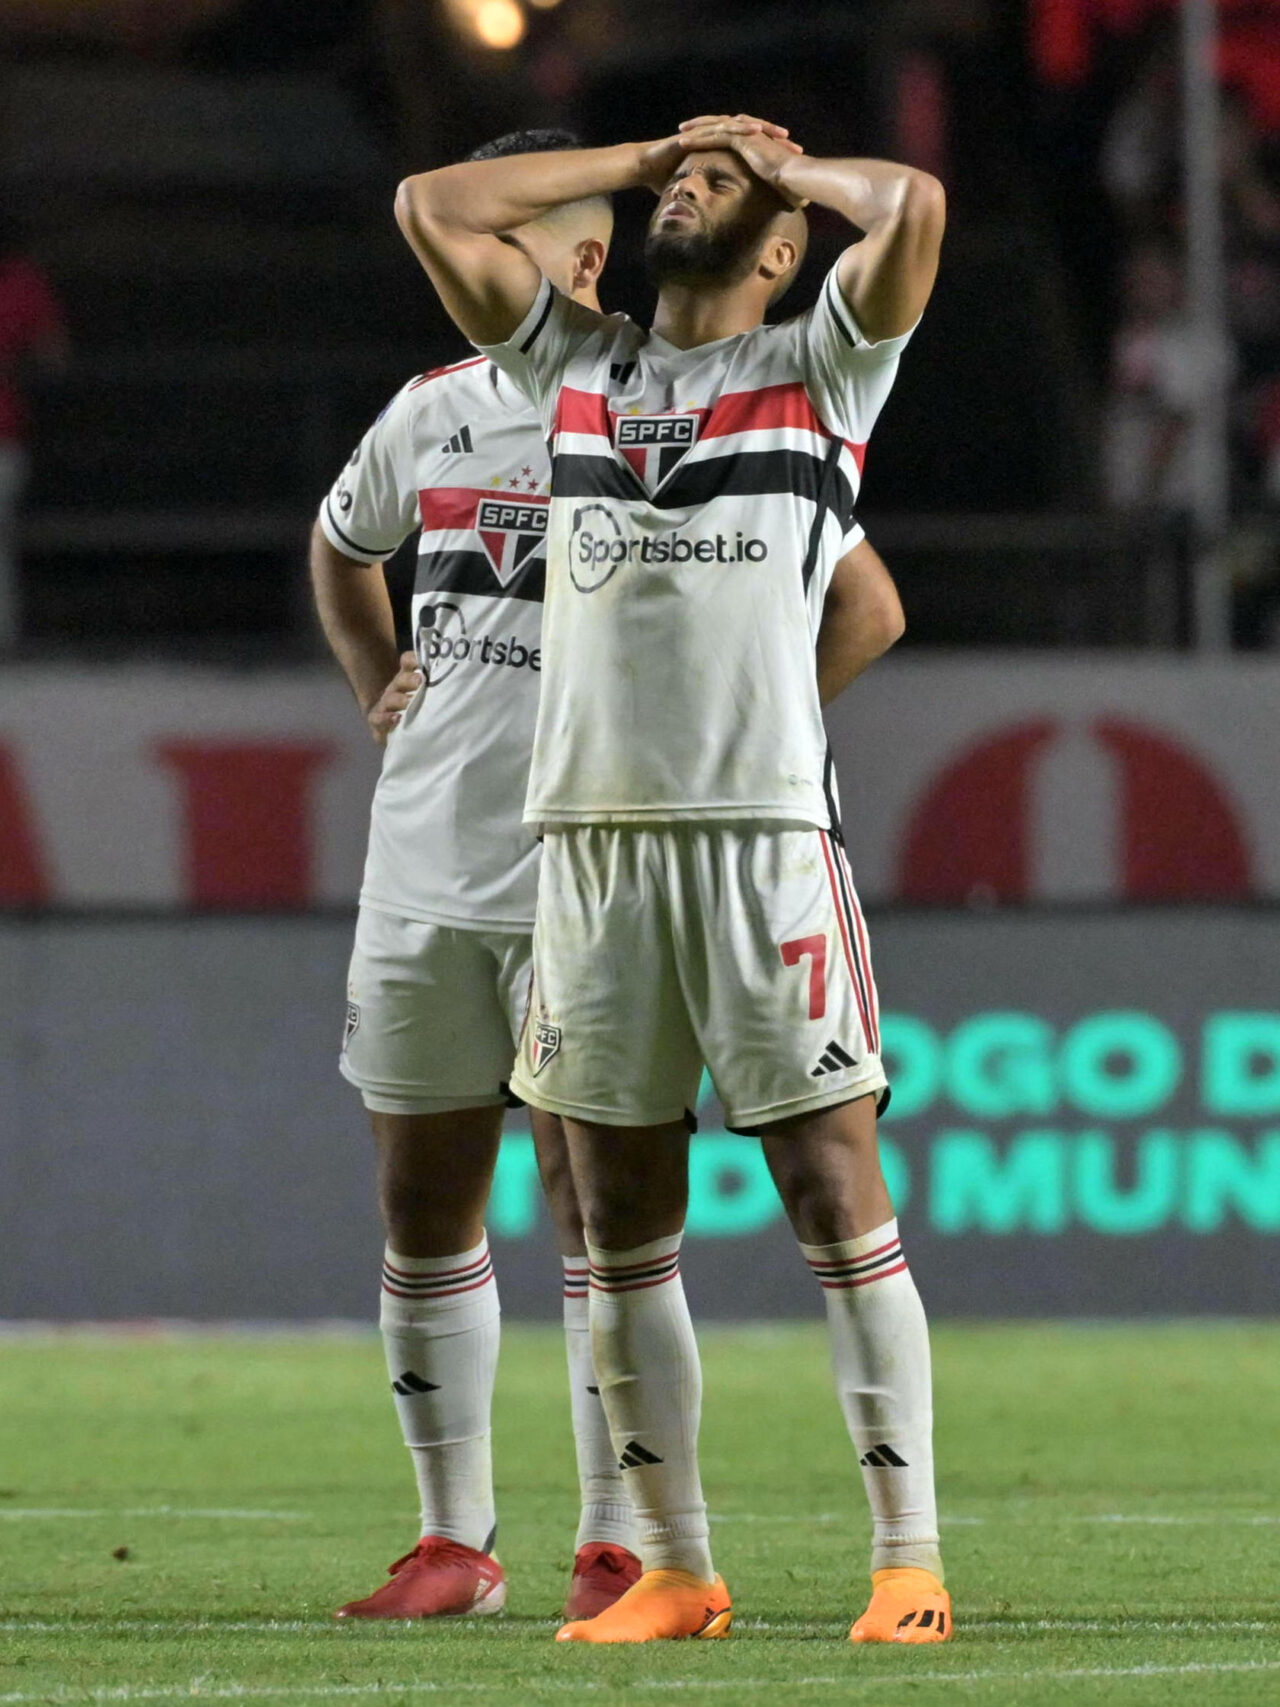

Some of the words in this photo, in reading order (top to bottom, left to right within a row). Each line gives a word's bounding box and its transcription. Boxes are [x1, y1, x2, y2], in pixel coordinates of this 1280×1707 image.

[621, 421, 691, 441] SPFC
[482, 506, 548, 529] SPFC
[579, 531, 768, 571] Sportsbet.io
[781, 934, 826, 1020] 7
